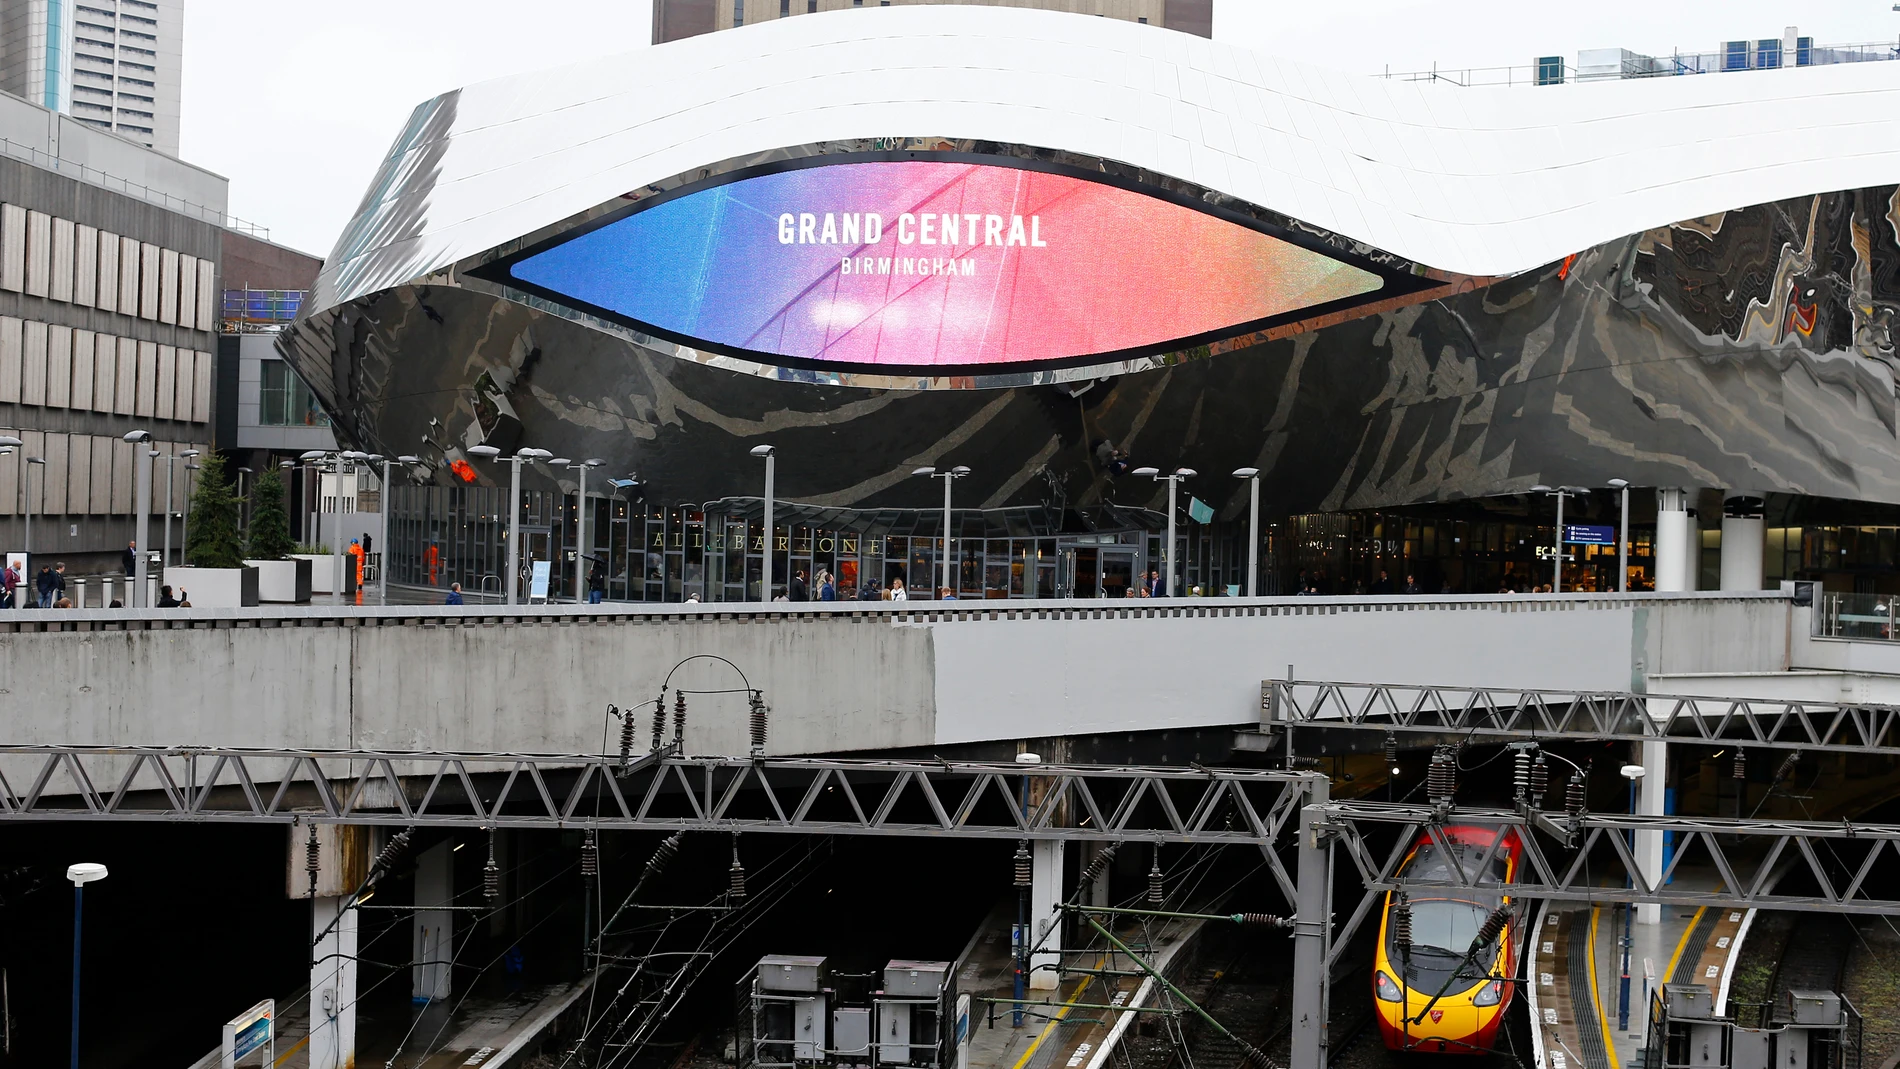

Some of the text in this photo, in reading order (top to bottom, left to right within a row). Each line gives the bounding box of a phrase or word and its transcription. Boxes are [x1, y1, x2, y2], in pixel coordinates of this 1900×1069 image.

[777, 212, 1047, 248] GRAND CENTRAL
[841, 256, 976, 276] BIRMINGHAM
[652, 532, 882, 555] ALL BAR ONE
